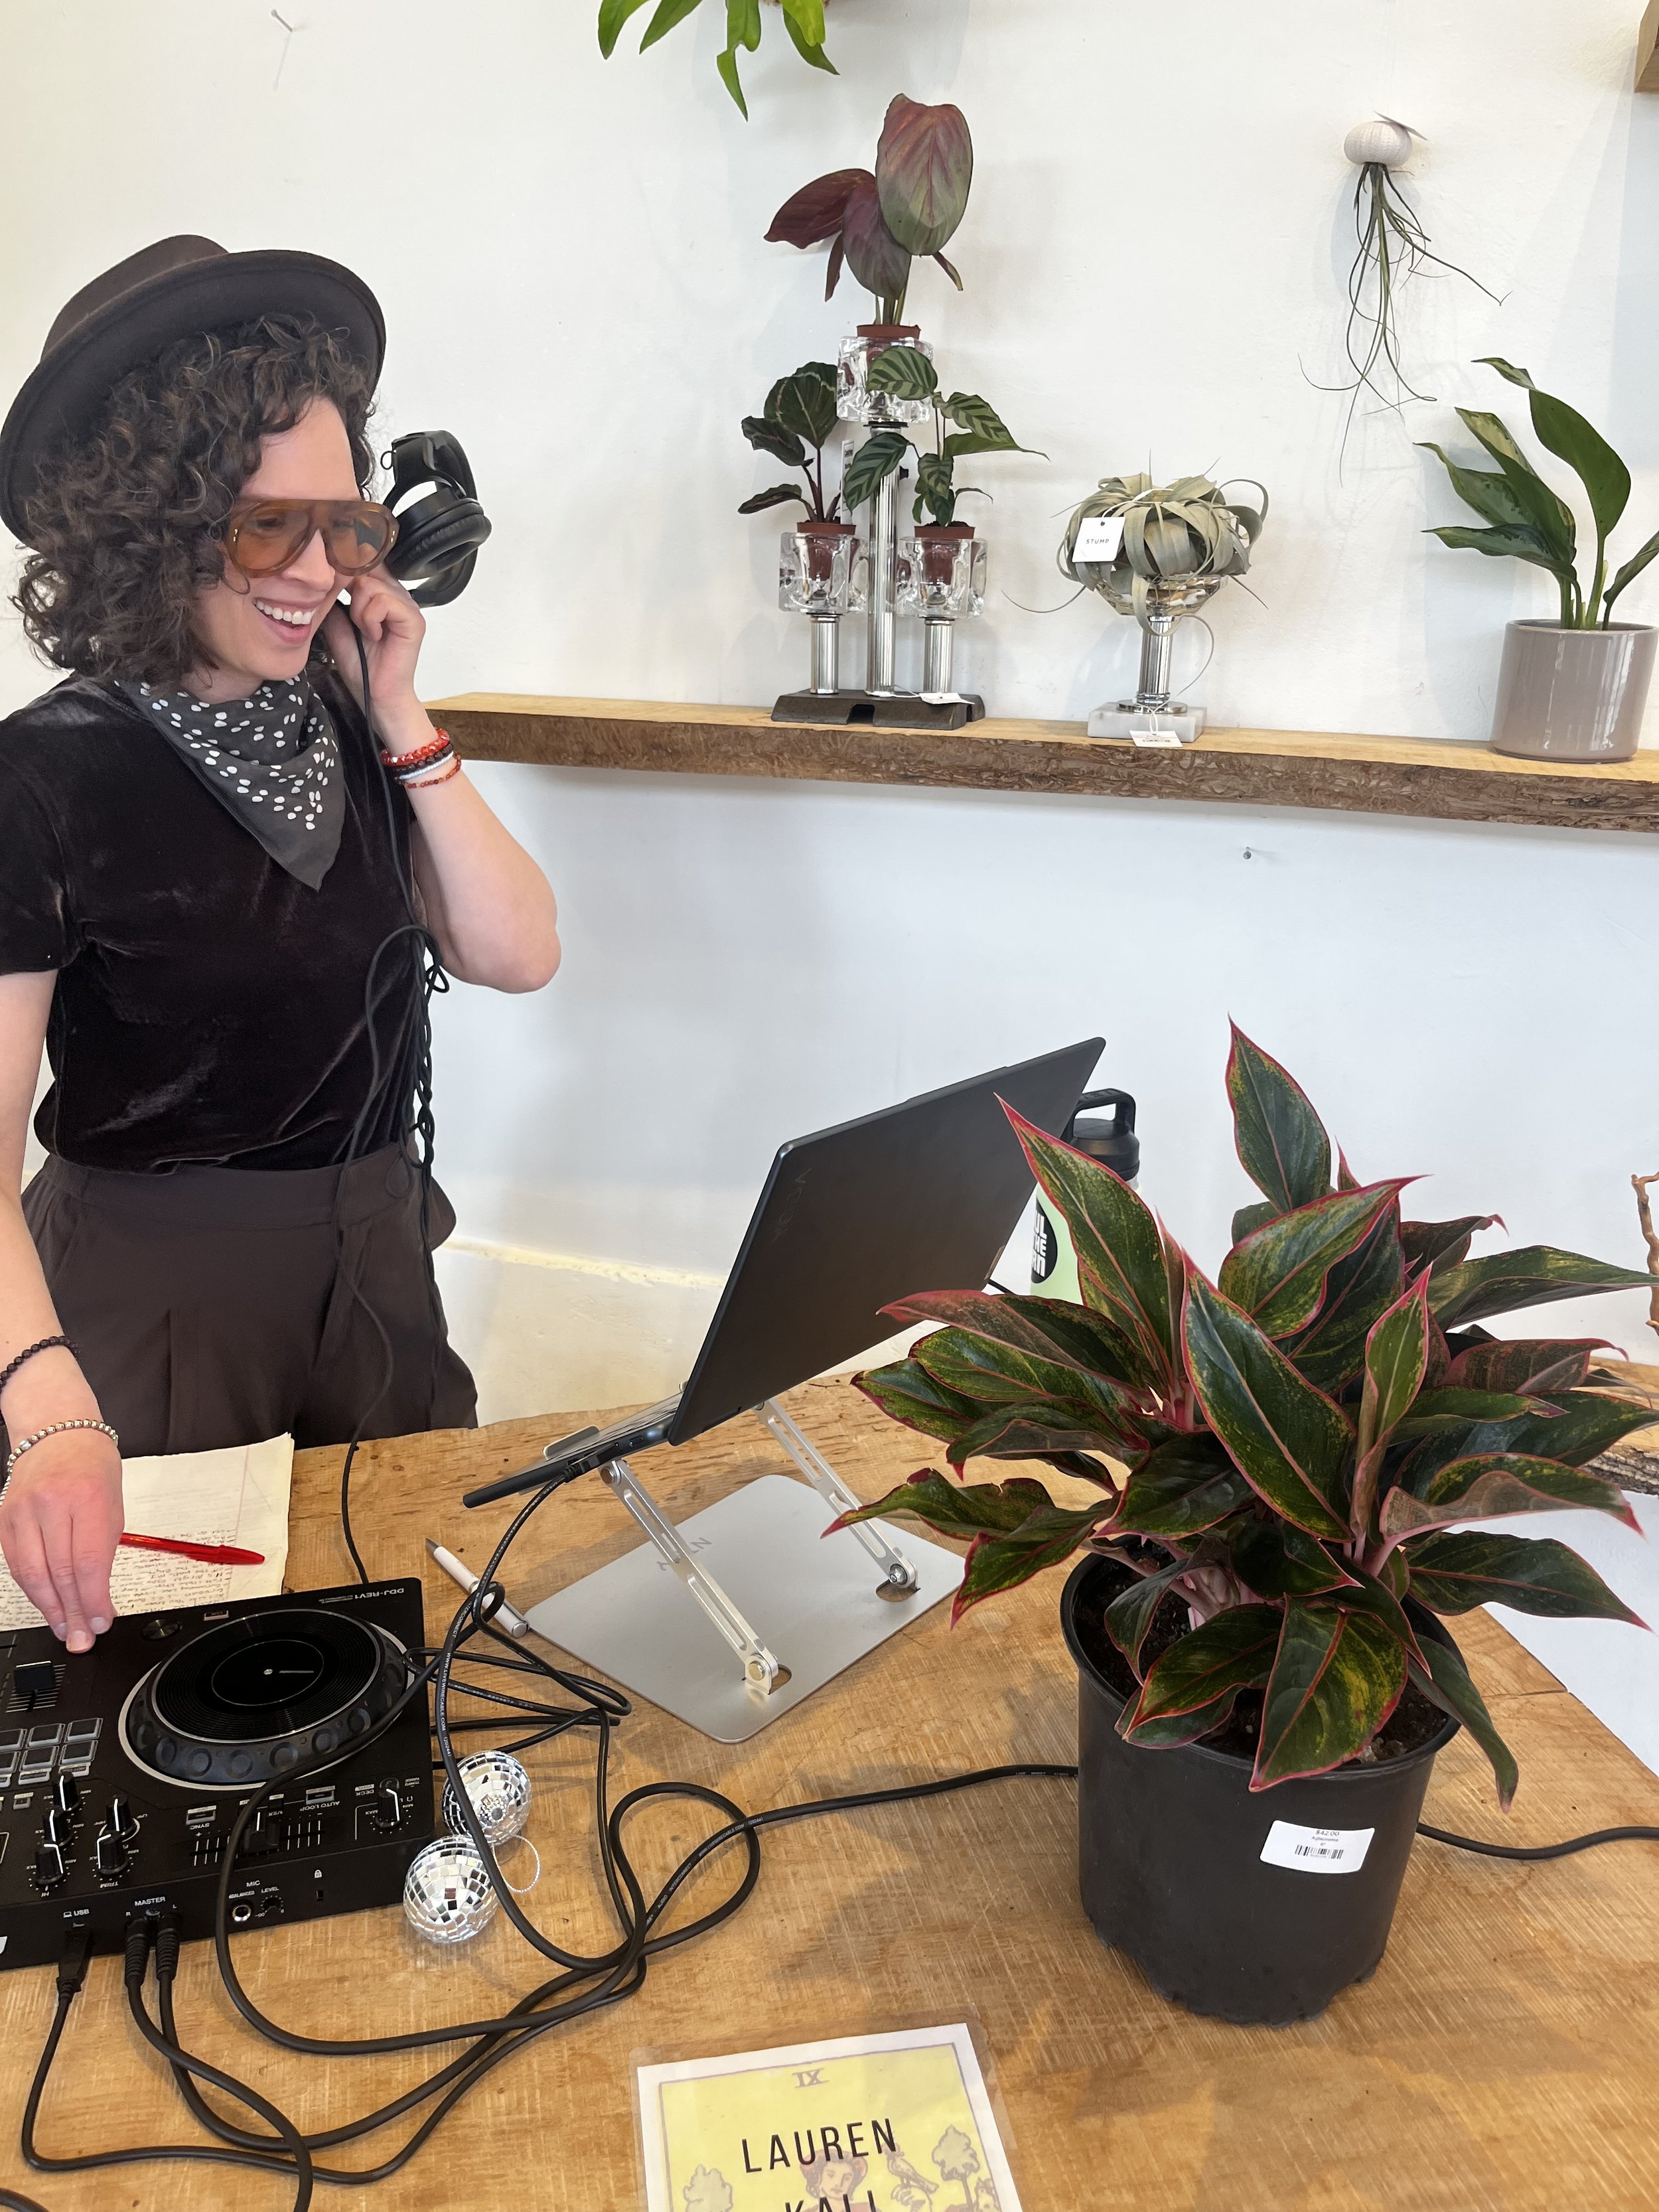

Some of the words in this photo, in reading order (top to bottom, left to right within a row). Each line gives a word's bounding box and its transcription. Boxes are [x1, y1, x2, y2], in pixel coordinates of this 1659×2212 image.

[354, 1588, 403, 1598] DDJ-REV1
[452, 1603, 472, 1639] TERCONNECT
[443, 1736, 453, 1757] (20244)
[134, 1896, 166, 1907] MASTER
[657, 1894, 668, 1909] AUDIO
[792, 2067, 830, 2089] IX
[742, 2118, 898, 2174] LAUREN
